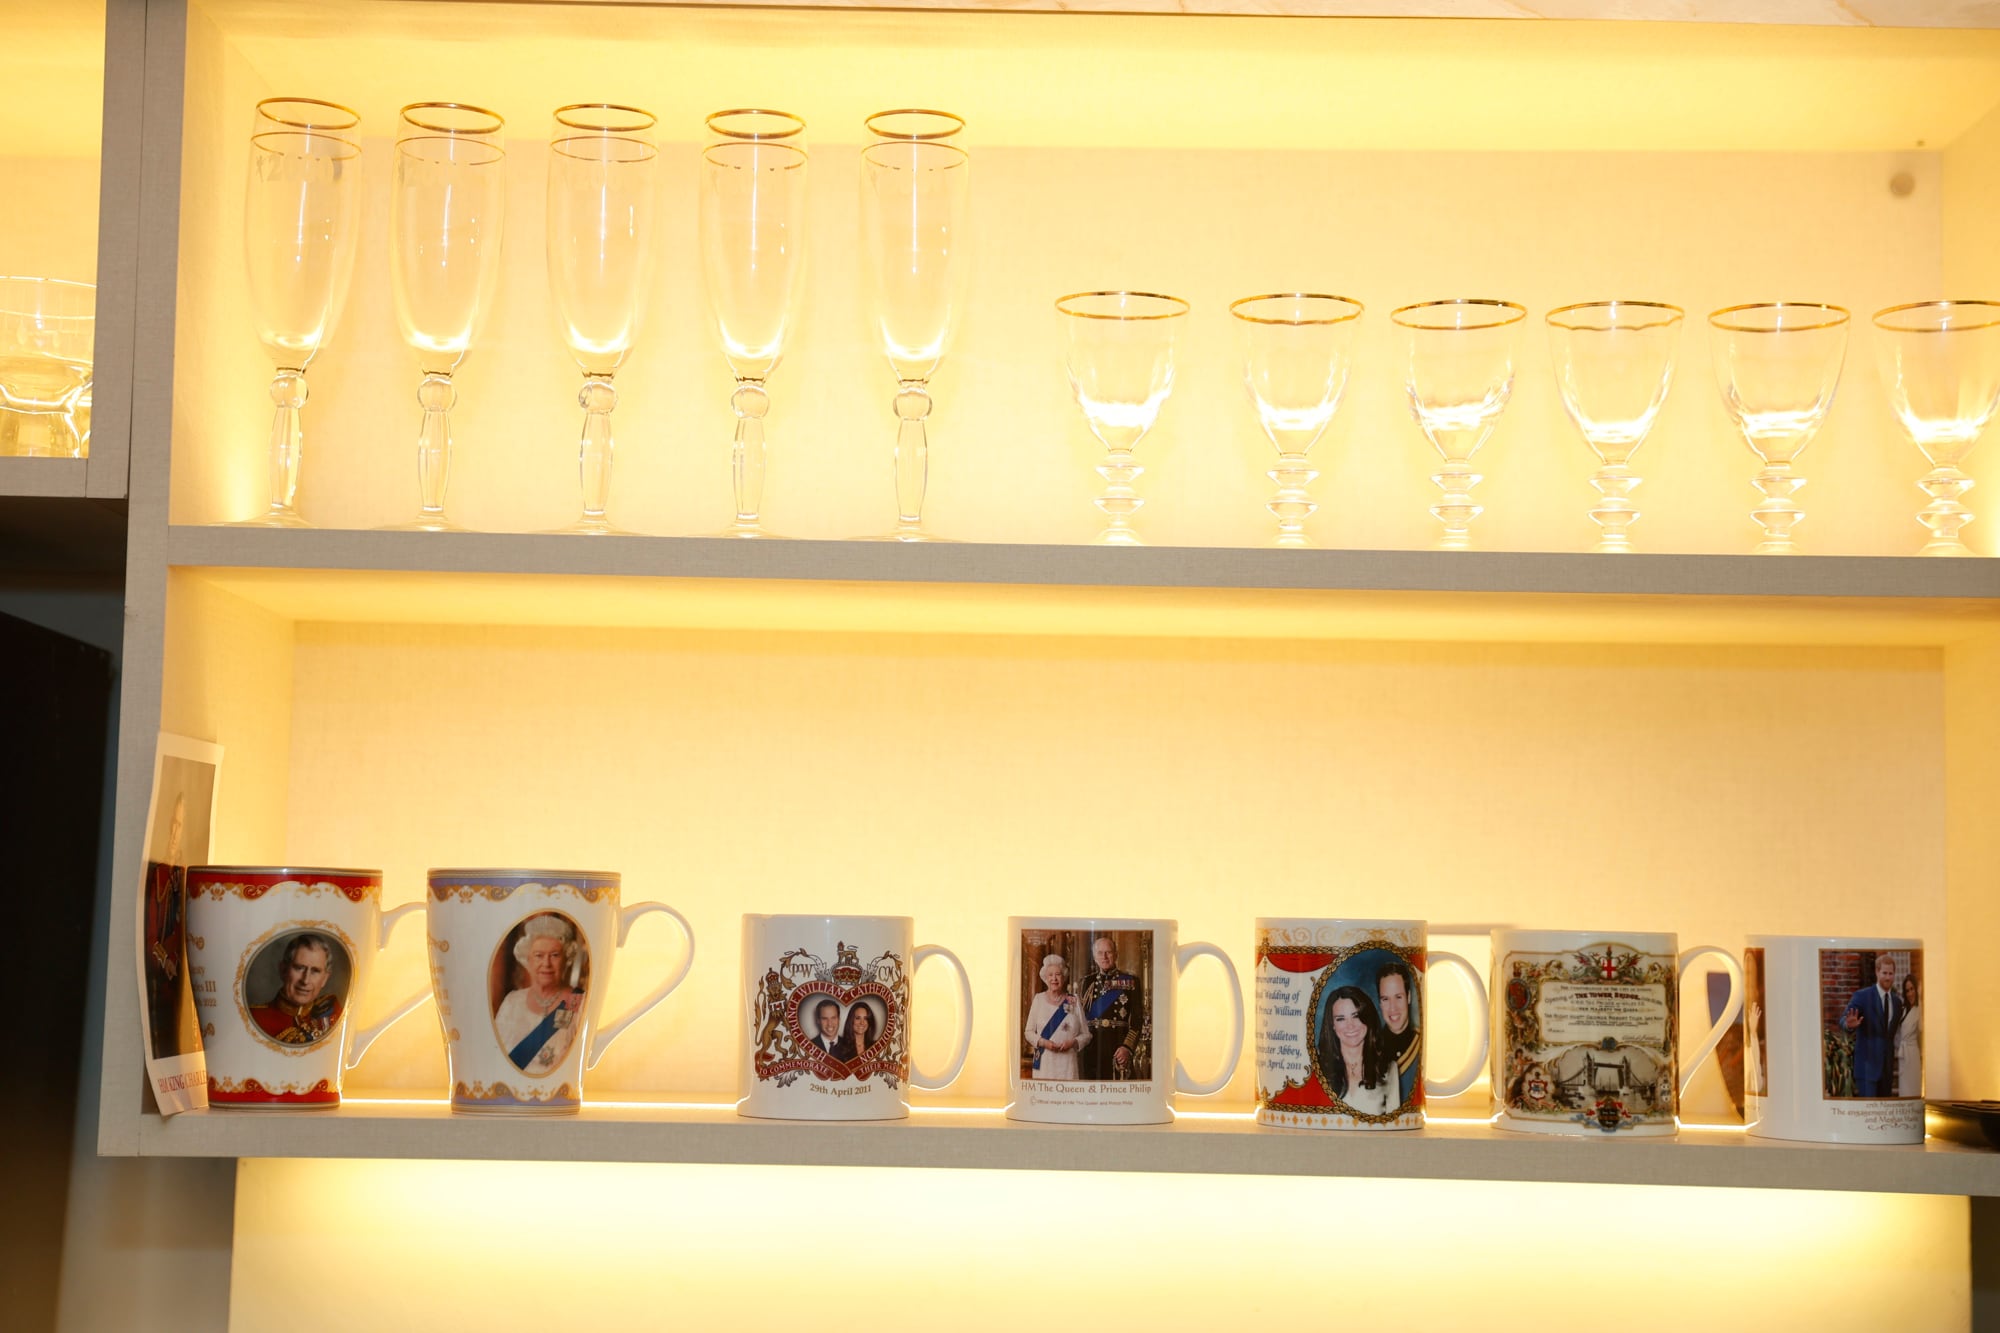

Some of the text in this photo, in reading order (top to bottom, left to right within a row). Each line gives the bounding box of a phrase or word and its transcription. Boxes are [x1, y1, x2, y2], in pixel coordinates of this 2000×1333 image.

[1292, 990, 1302, 1003] of
[788, 998, 802, 1038] PRINCE
[797, 982, 845, 999] WILLIAM
[1274, 1004, 1302, 1017] William
[1265, 1030, 1298, 1041] Middleton
[1277, 1045, 1302, 1059] Abbey,
[769, 1061, 828, 1075] COMMEMORATE
[1267, 1059, 1285, 1071] April,
[1286, 1062, 1302, 1071] 2011
[809, 1083, 872, 1097] 29th April 2011
[1021, 1082, 1152, 1095] HM The Queen & Prince Philip
[1831, 1107, 1846, 1115] The
